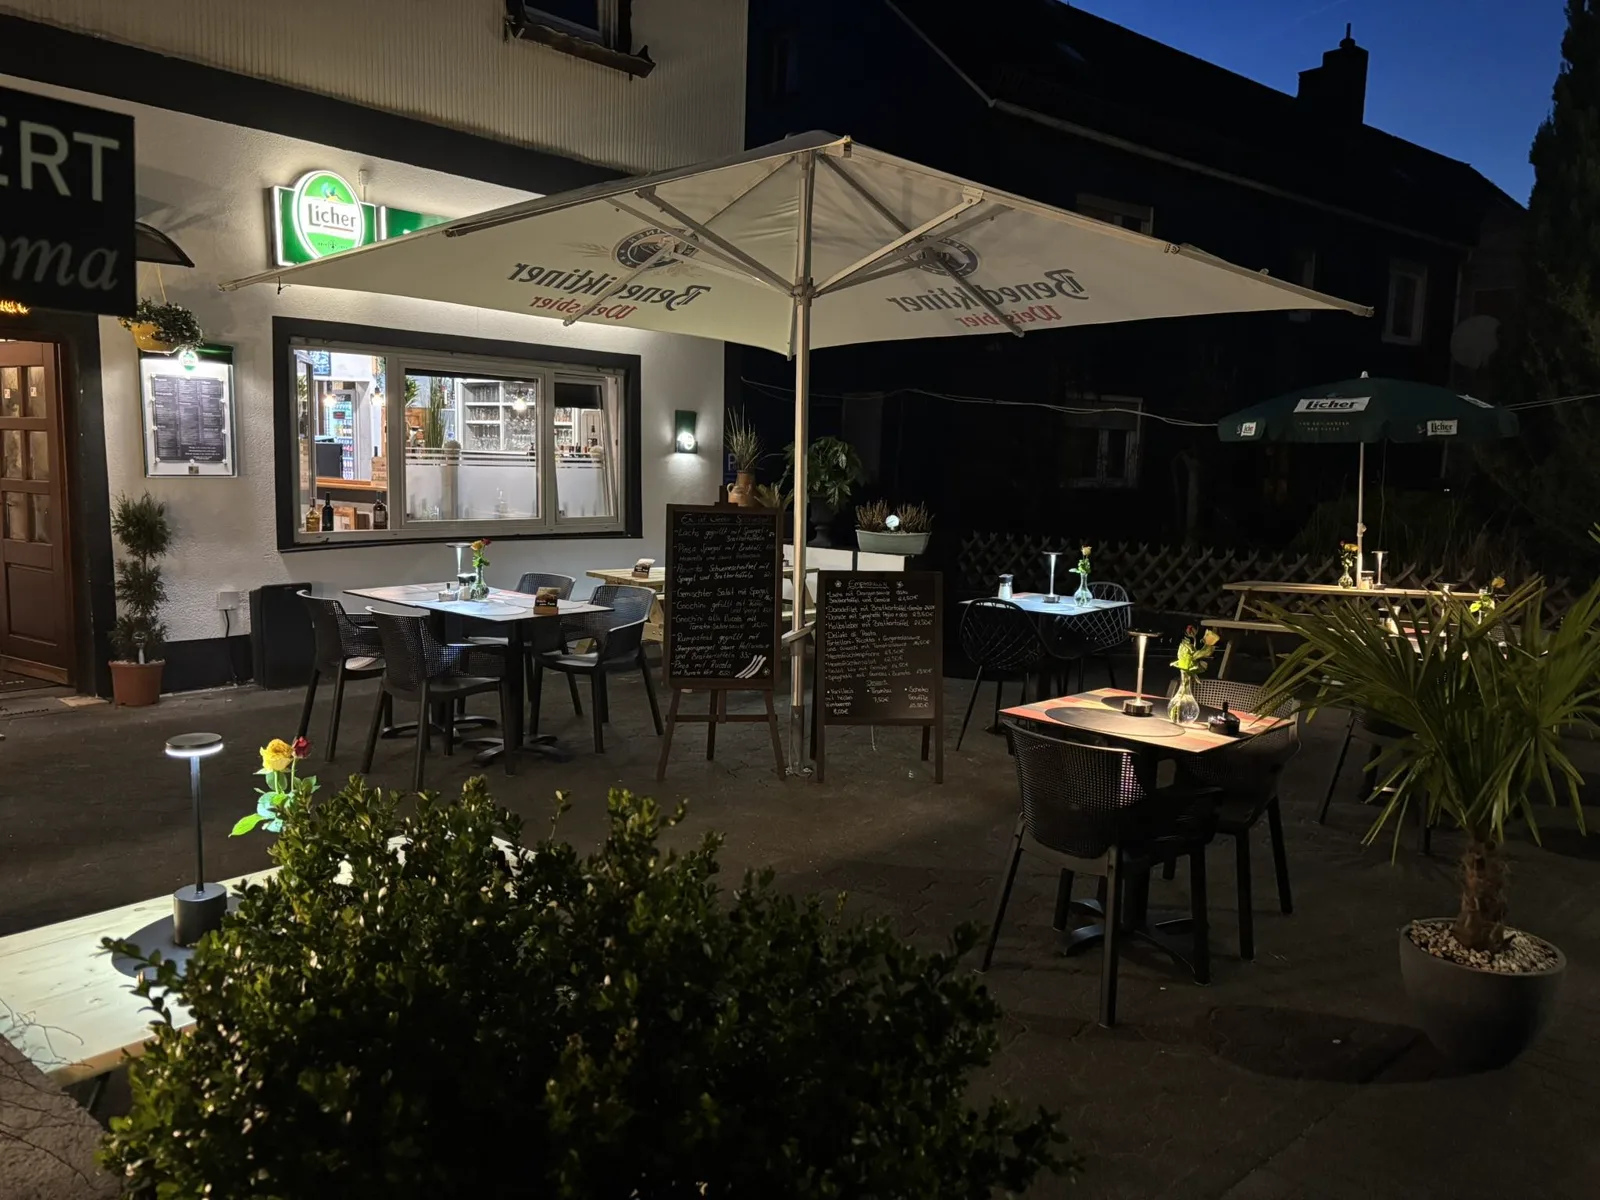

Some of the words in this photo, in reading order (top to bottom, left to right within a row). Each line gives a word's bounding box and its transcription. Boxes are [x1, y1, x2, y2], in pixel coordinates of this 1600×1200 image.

[0, 116, 120, 202] RT
[308, 203, 356, 229] Licher
[1306, 400, 1360, 410] Licher
[1431, 423, 1453, 433] Licher
[677, 587, 713, 598] Gemischter
[717, 587, 734, 596] Salat
[748, 632, 760, 640] mit
